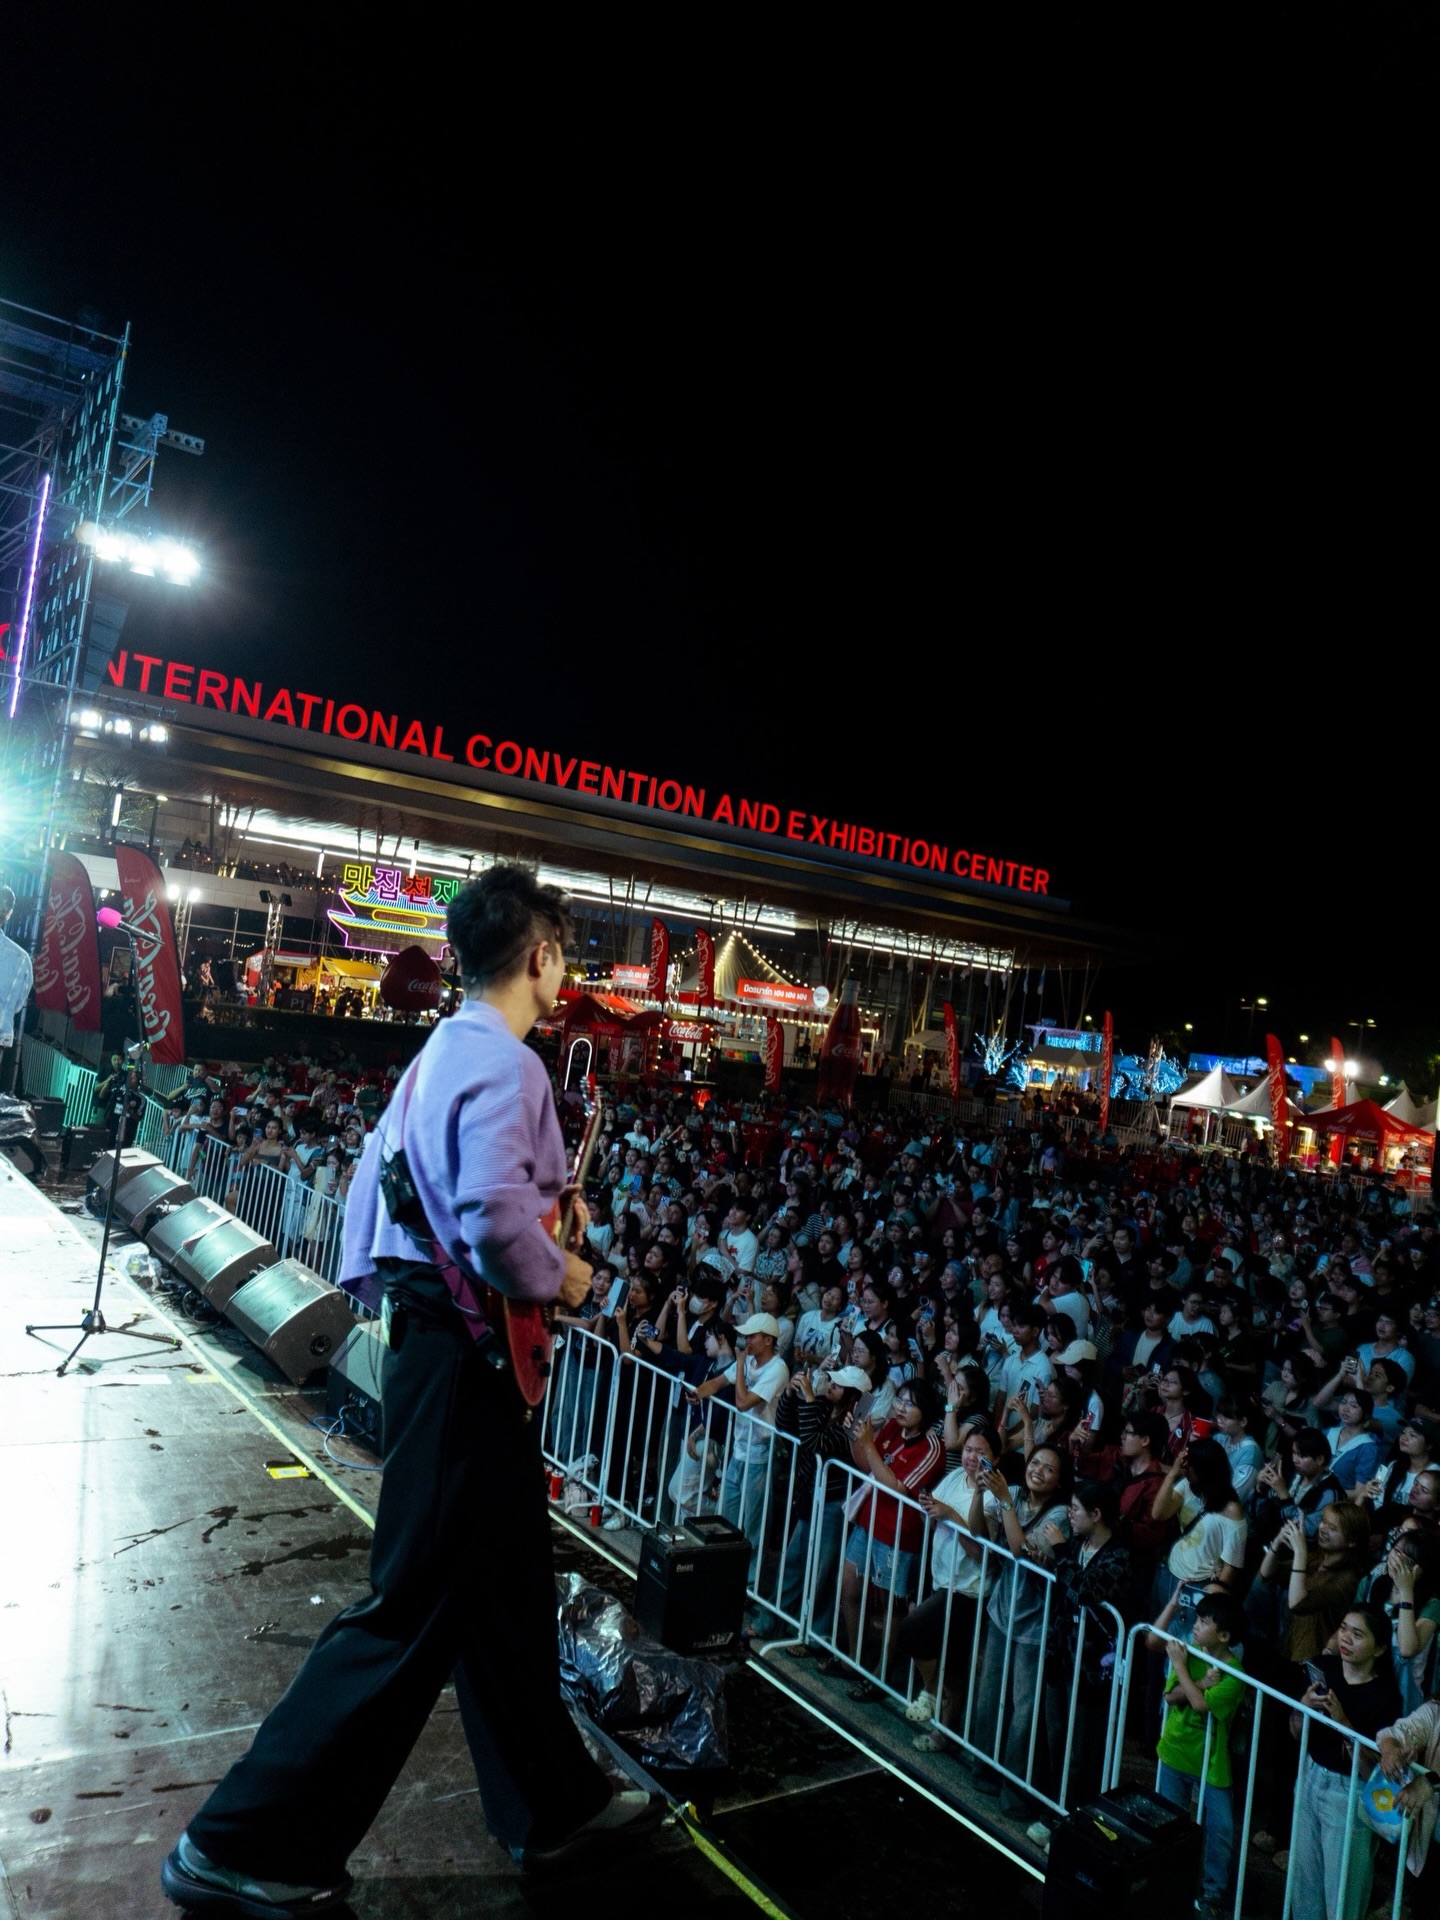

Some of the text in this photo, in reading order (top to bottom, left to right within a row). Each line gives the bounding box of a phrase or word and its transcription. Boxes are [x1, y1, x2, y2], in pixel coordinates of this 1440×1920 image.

[107, 650, 1050, 894] NTERNATIONAL CONVENTION AND EXHIBITION CENTER
